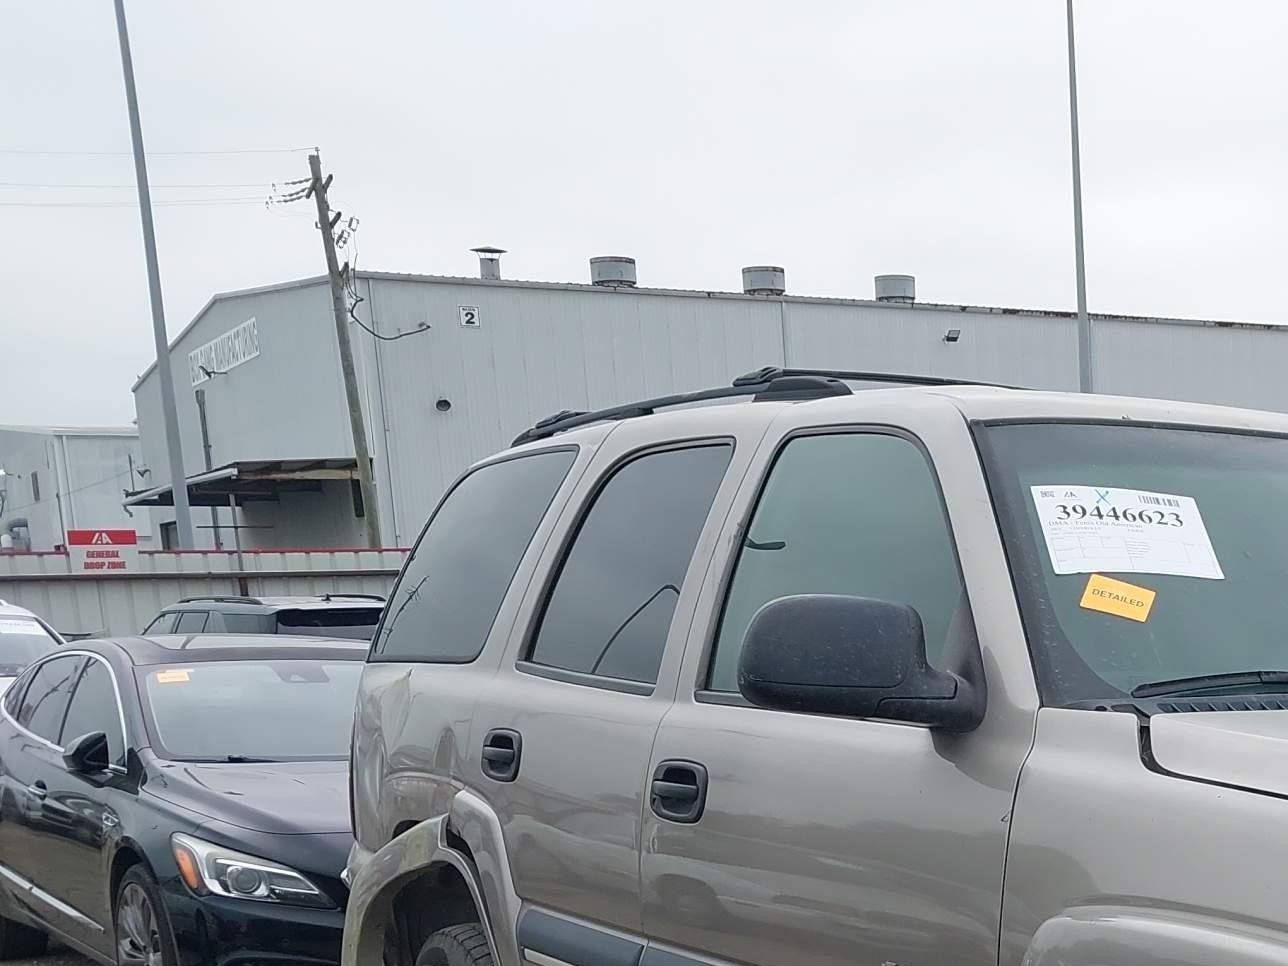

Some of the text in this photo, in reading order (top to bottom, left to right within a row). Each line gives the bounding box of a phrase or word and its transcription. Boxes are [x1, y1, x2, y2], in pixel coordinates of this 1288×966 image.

[465, 312, 475, 324] 2
[1055, 503, 1183, 528] 39446623
[86, 550, 120, 558] GENERAL
[84, 561, 126, 570] DROP ZONE
[1091, 588, 1145, 608] DETAILED
